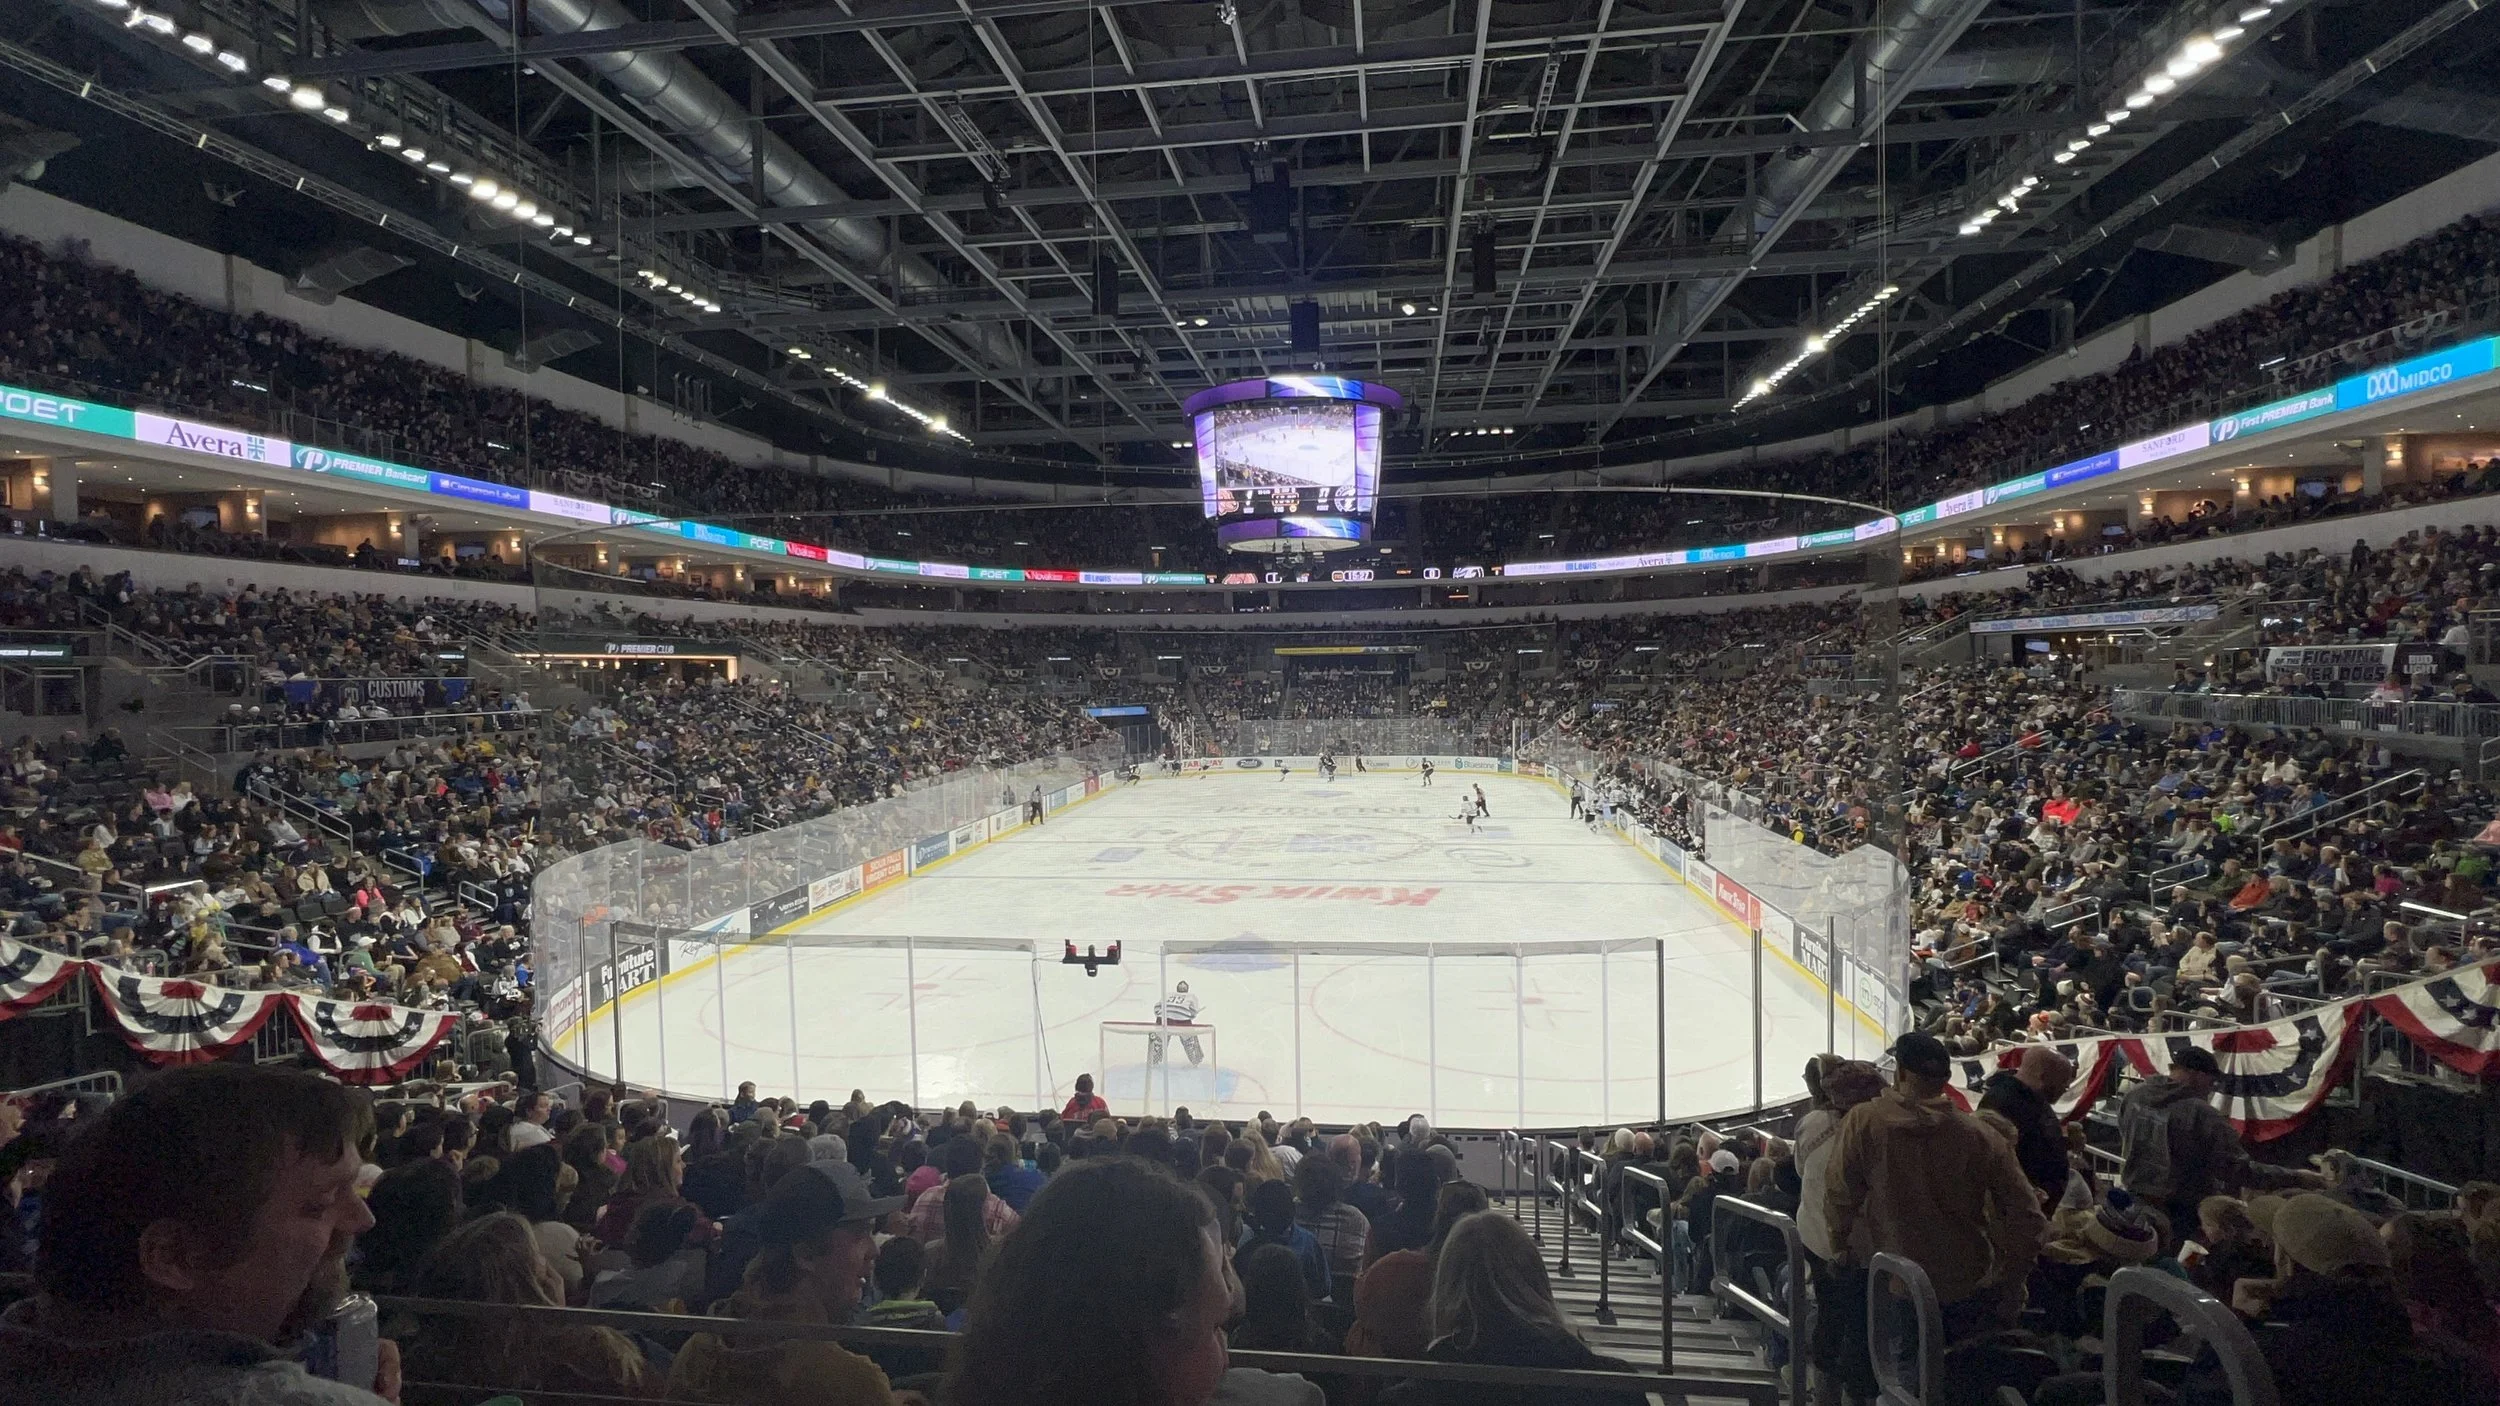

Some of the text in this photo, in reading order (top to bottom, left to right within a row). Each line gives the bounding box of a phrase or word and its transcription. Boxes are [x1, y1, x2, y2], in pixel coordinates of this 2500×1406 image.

[2401, 364, 2453, 389] MIDCO
[0, 391, 86, 423] OET
[2241, 393, 2334, 430] First PREMIER Bank
[166, 422, 243, 457] Avera
[332, 457, 428, 485] PREMIER Bankcard
[1944, 500, 1967, 517] Avera
[1573, 561, 1598, 571] Lewis
[1636, 557, 1665, 568] Avera
[980, 570, 1010, 579] POET
[620, 644, 675, 654] PREMIER CLUB
[2408, 654, 2434, 665] BUD
[2338, 666, 2388, 681] DOGS
[2403, 664, 2439, 675] LIGHT
[368, 680, 425, 699] CUSTOMS
[601, 948, 655, 984] Funiture
